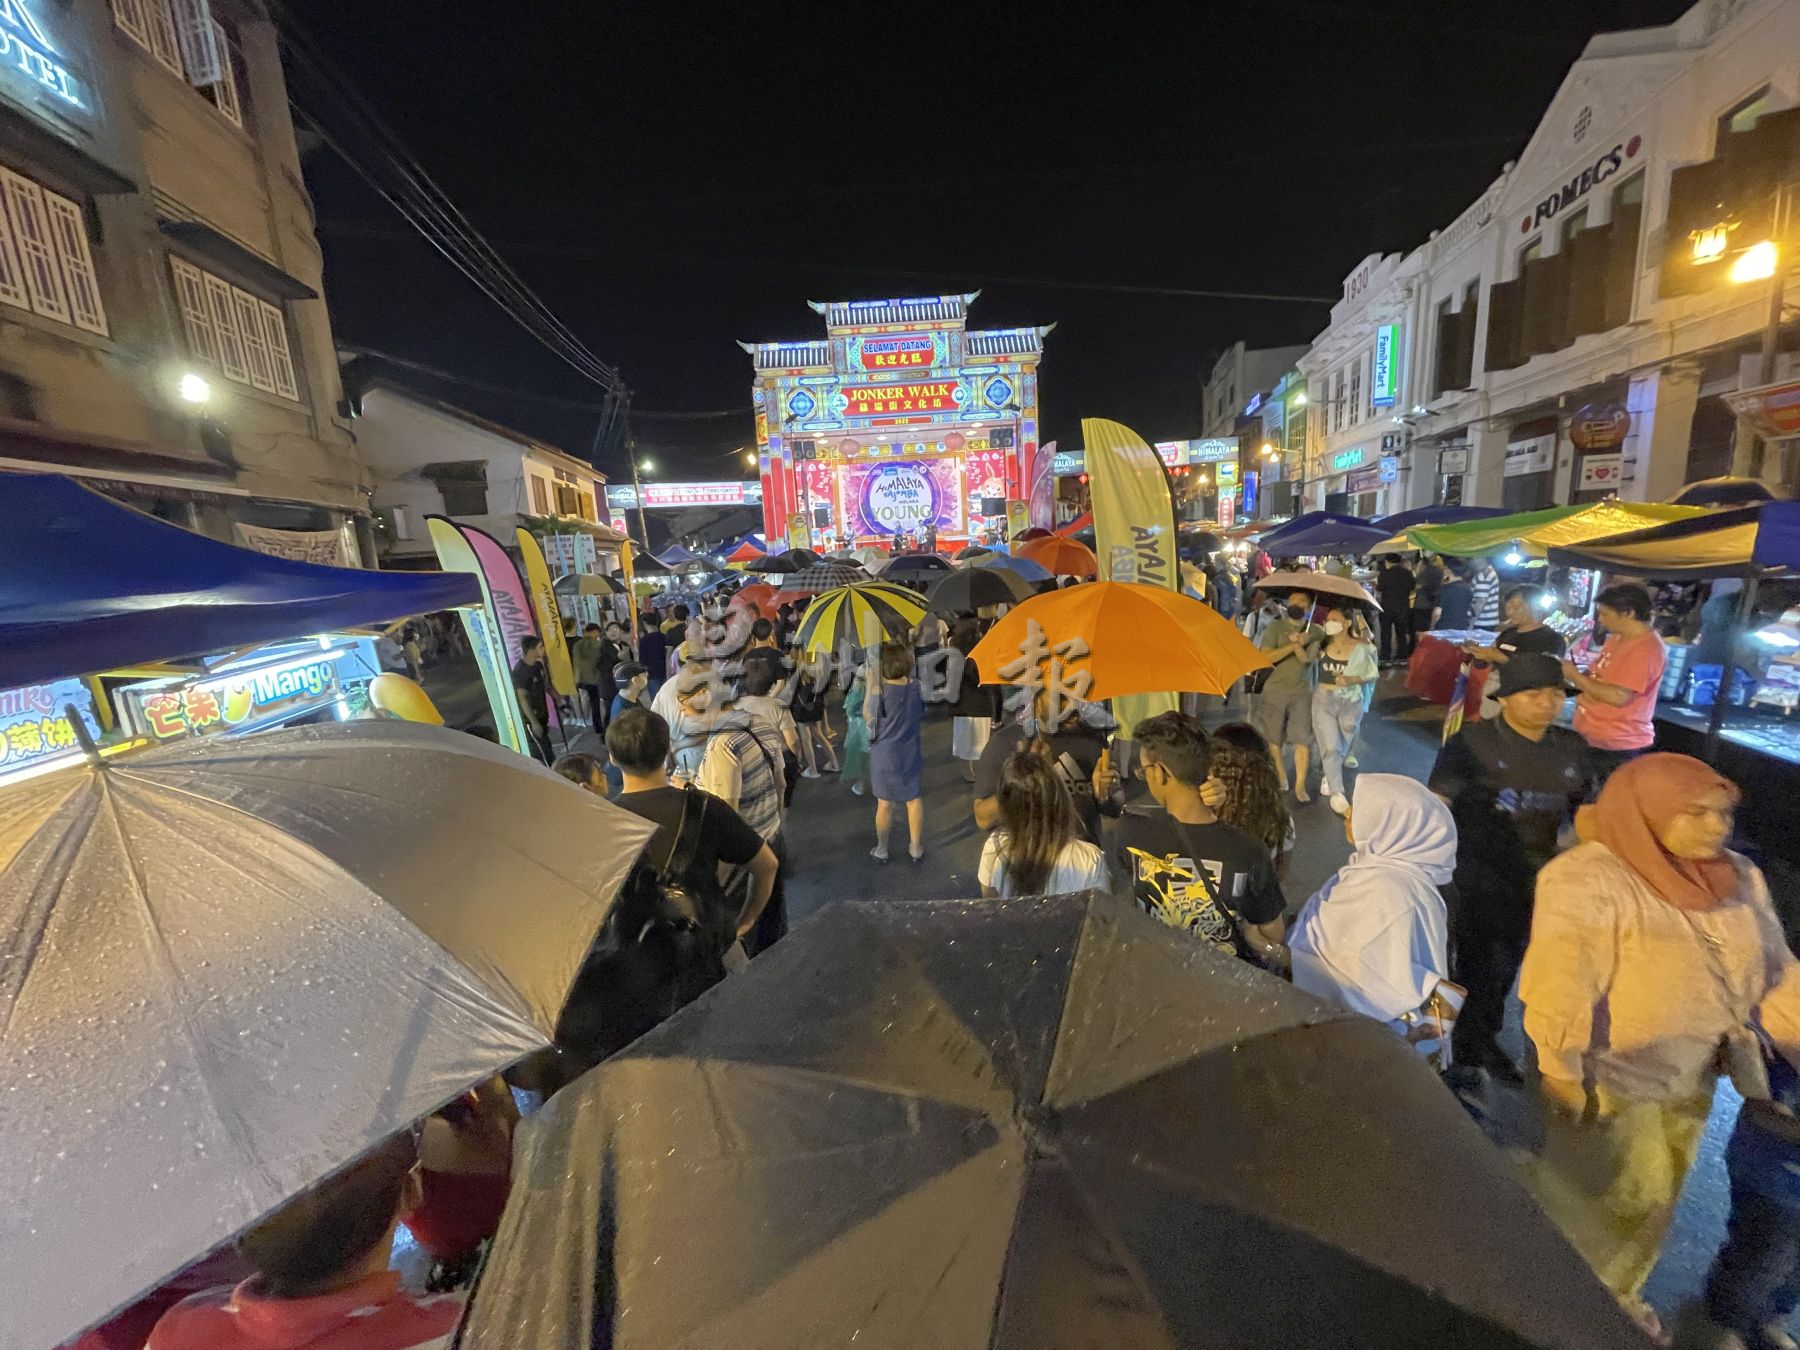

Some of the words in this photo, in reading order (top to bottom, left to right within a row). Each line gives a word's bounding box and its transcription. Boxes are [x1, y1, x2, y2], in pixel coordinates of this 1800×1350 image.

[1533, 143, 1623, 230] FOMECS
[863, 342, 899, 354] SELAMAT
[901, 340, 932, 351] DATANG
[1377, 335, 1389, 388] FamilyMart
[851, 387, 905, 402] JONKER
[907, 384, 949, 398] WALK
[871, 505, 932, 521] YOUNG
[1323, 662, 1345, 672] SAIN
[255, 661, 333, 704] Mango
[144, 684, 221, 738] 芒果
